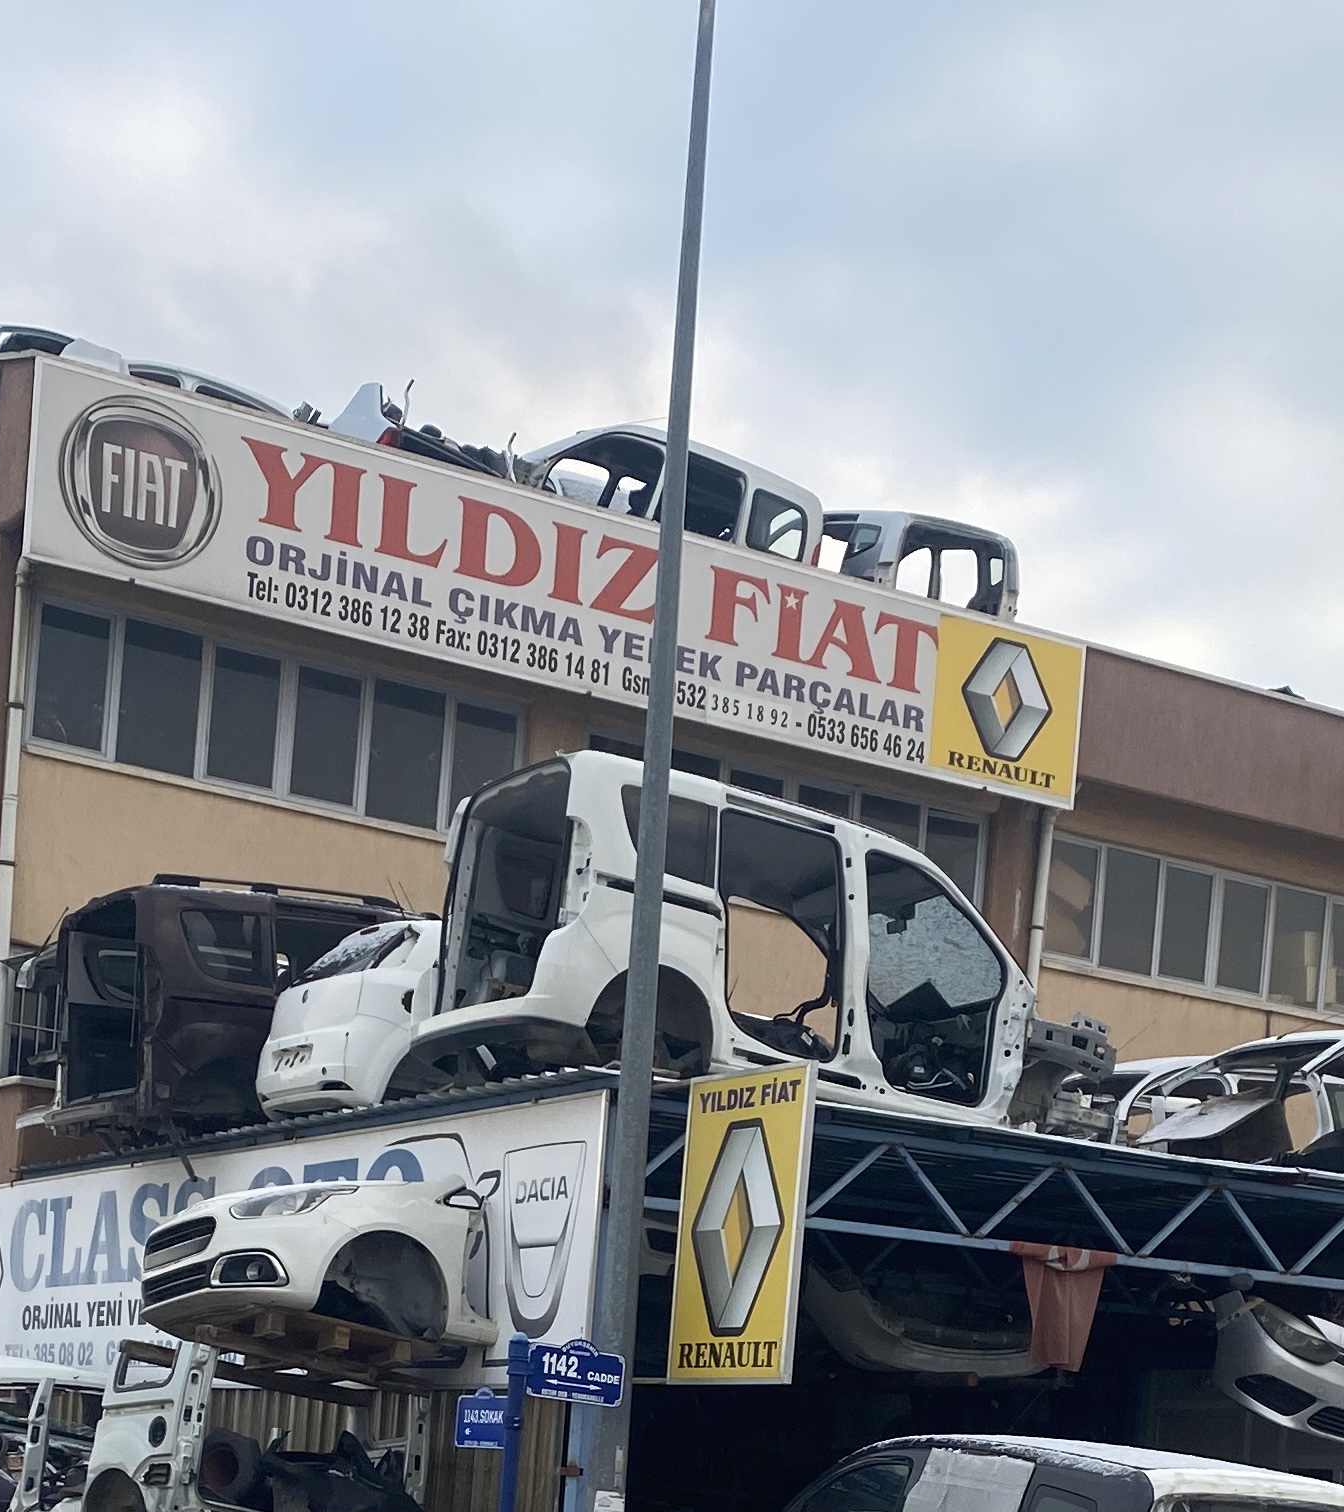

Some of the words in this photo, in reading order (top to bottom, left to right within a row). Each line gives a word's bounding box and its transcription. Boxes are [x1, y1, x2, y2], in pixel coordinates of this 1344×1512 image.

[100, 441, 189, 529] FIAT
[241, 435, 659, 624] YILDIZ
[245, 535, 433, 608] ORJİNAL
[447, 586, 584, 647] ÇIKMA
[598, 624, 723, 682] YEEK
[735, 660, 925, 733] PARÇALAR
[247, 571, 279, 604] Tel:
[285, 581, 332, 618] 0312
[338, 594, 373, 627] 386
[379, 605, 402, 634] 12
[406, 611, 430, 642] 38
[435, 619, 471, 652] Fax:
[476, 629, 521, 664] 0312
[526, 642, 559, 673] 386
[564, 652, 585, 680] 14
[590, 661, 610, 686] 81
[674, 679, 707, 710] 532
[711, 693, 740, 717] 385
[747, 702, 764, 723] 18
[770, 708, 789, 729] 92
[807, 712, 846, 745] 0533
[850, 723, 878, 753] 656
[883, 732, 902, 758] 46
[906, 738, 925, 764] 24
[947, 749, 1056, 790] RENAULT
[699, 1085, 755, 1114] YILDIZ
[760, 1076, 802, 1107] FİAT
[515, 1174, 569, 1205] DACIA
[21, 1296, 82, 1331] ORJİNAL
[86, 1292, 123, 1329] YENİ
[34, 1342, 55, 1364] 385
[58, 1342, 74, 1366] 08
[77, 1341, 93, 1366] 02
[542, 1351, 582, 1380] 1142.
[587, 1371, 621, 1385] CADDE
[678, 1341, 777, 1369] RENAULT
